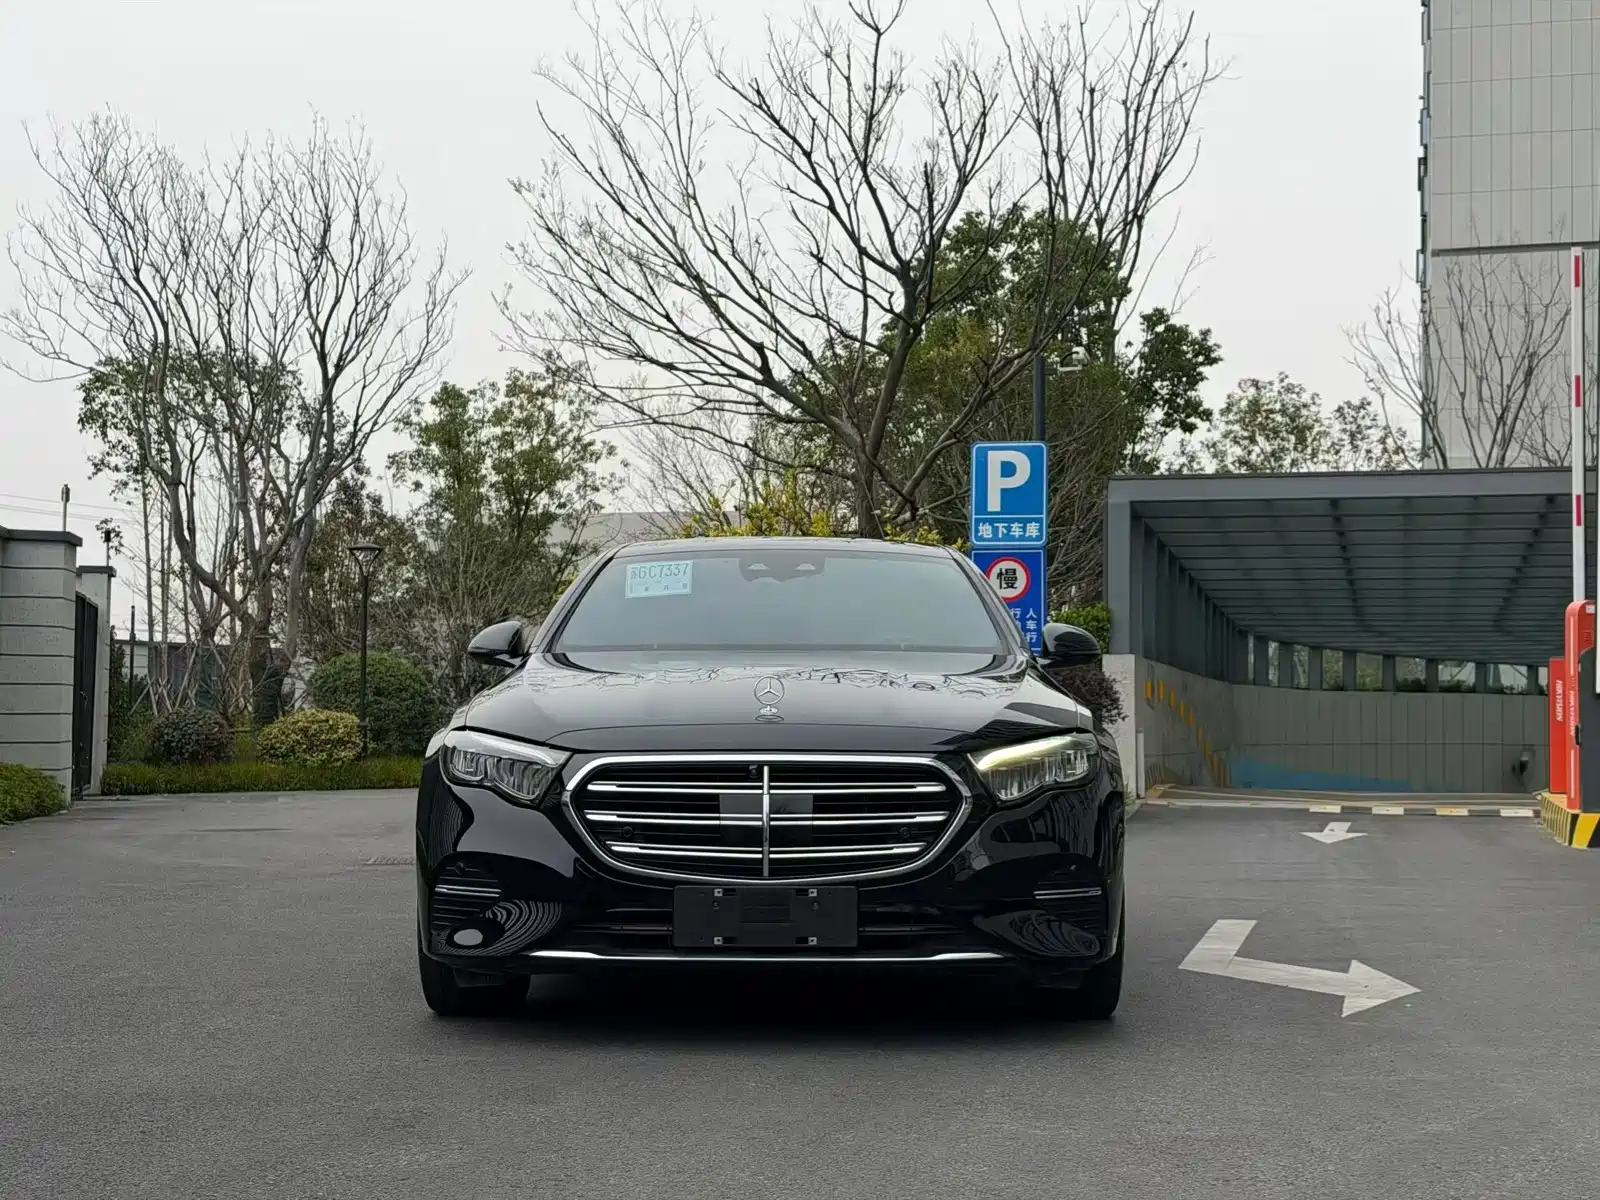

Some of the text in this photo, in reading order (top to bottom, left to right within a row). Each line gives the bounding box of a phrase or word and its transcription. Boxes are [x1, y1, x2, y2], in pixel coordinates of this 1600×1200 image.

[987, 450, 1031, 512] P
[978, 522, 1040, 538] 地下车库
[996, 568, 1018, 590] 慢
